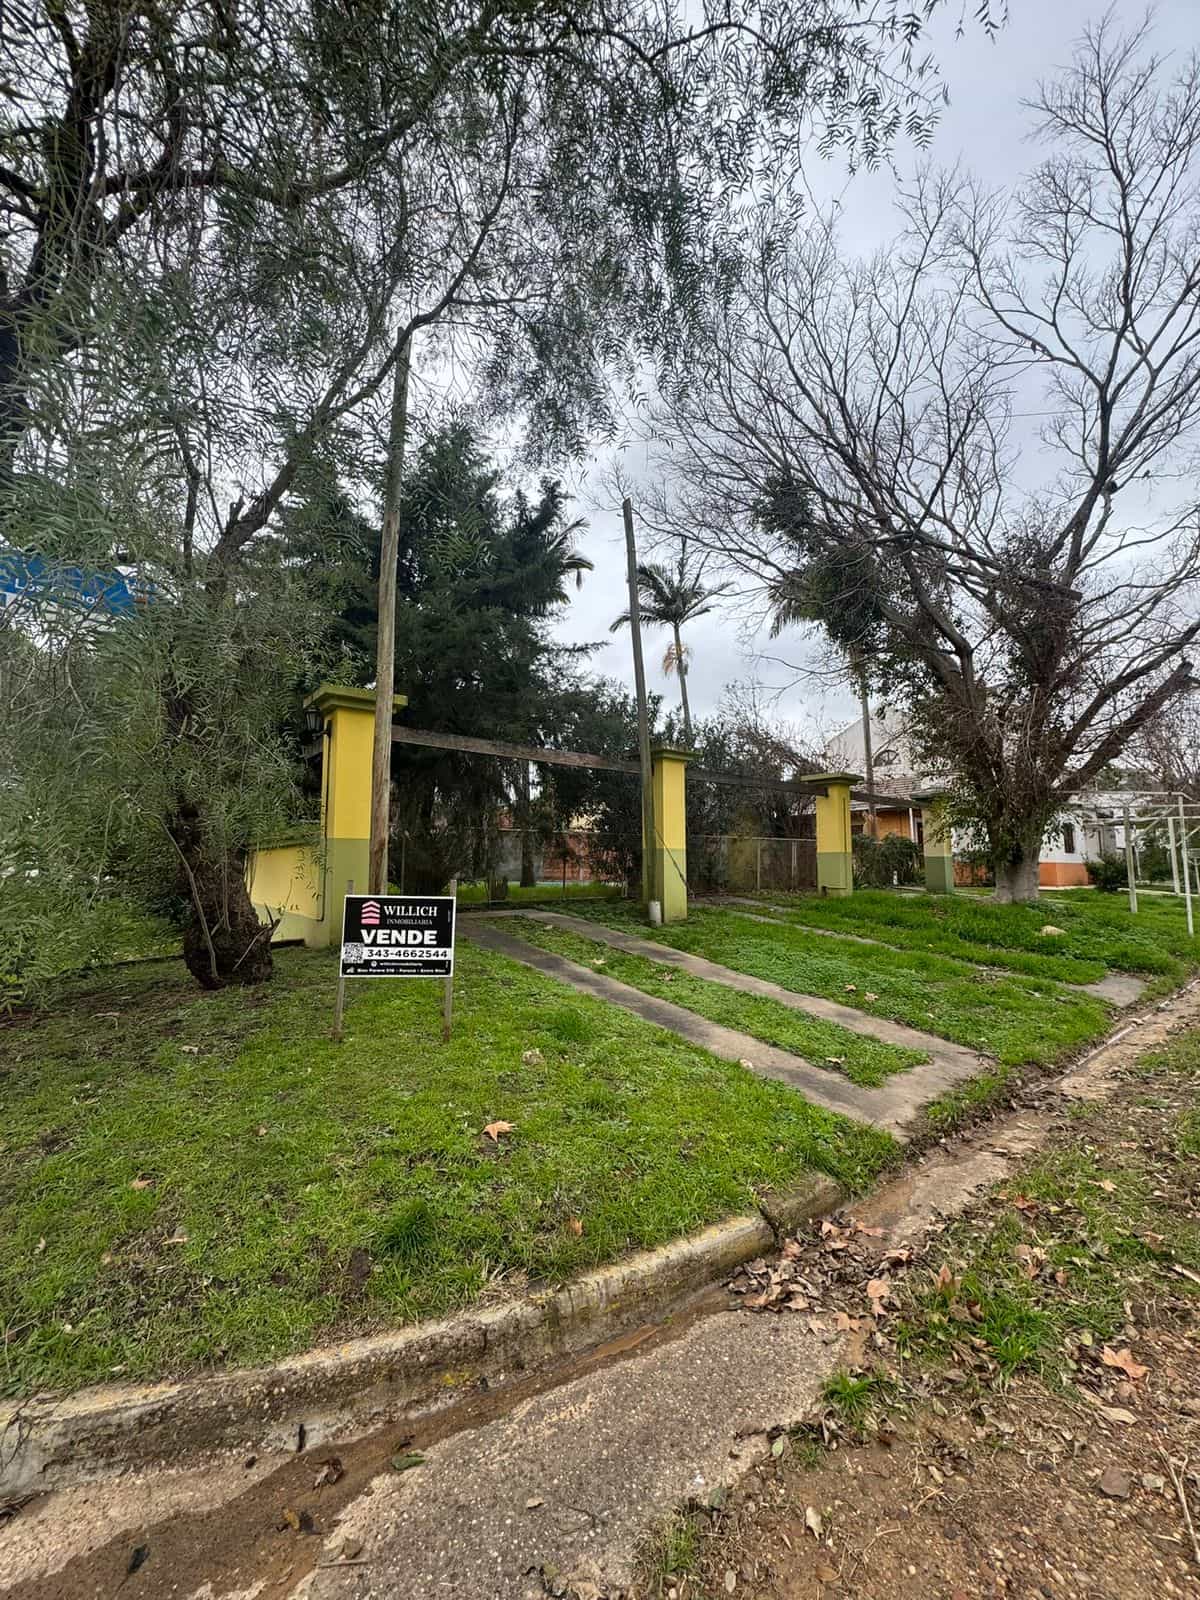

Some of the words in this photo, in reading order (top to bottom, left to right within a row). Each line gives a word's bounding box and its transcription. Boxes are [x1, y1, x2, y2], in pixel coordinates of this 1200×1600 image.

[383, 905, 438, 917] WILLICH
[386, 918, 433, 926] INMOBILIARIA
[360, 929, 438, 945] VENDE
[367, 949, 448, 958] 343-4662544
